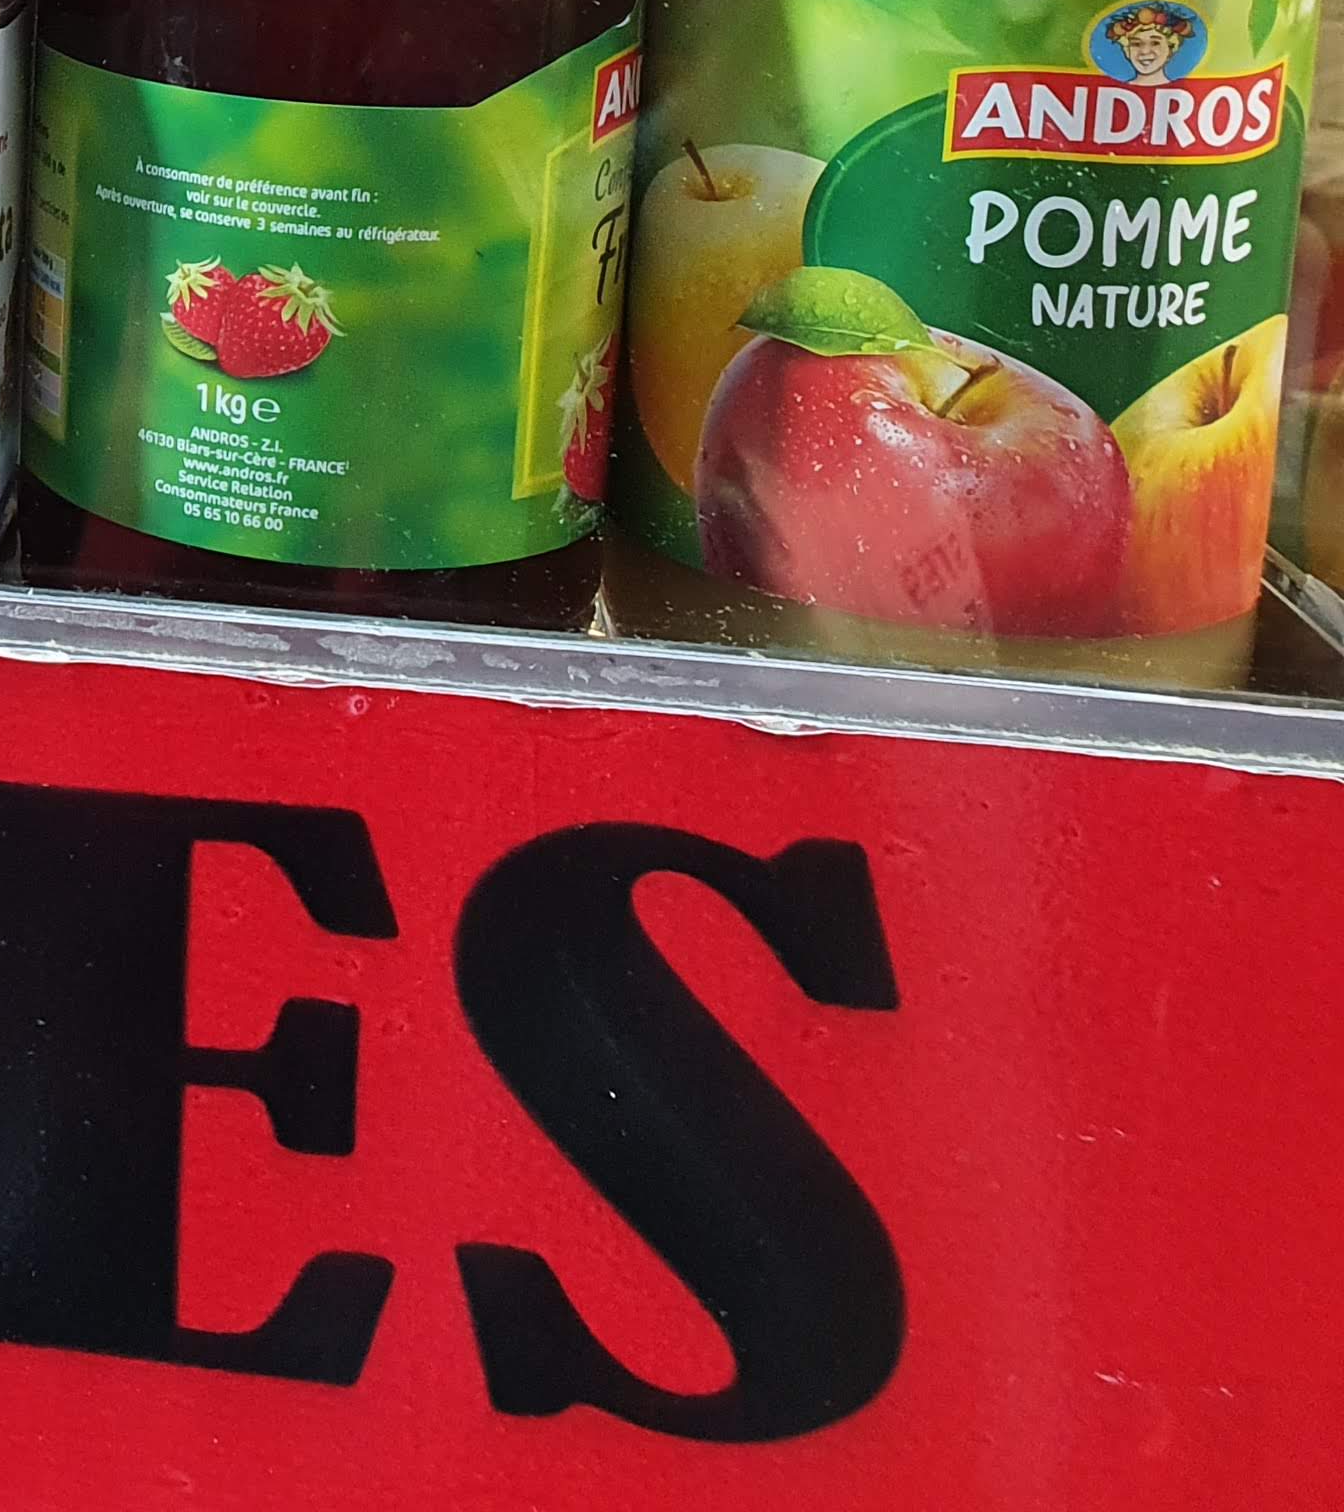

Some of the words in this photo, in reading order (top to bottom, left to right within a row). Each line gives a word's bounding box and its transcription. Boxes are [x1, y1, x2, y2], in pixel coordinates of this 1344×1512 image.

[962, 78, 1274, 148] ANDROS
[135, 156, 144, 175] À
[145, 163, 215, 187] consommer
[216, 173, 234, 191] de
[235, 177, 308, 200] préférence
[310, 188, 350, 204] avant
[350, 188, 372, 205] fin
[95, 183, 123, 205] Après
[123, 193, 178, 221] ouverture,
[179, 206, 194, 221] se
[195, 210, 252, 230] conserve
[256, 217, 266, 232] 3
[269, 219, 333, 239] semaines
[335, 225, 353, 240] au
[358, 227, 442, 246] réfrigérateur.
[185, 189, 211, 207] voir
[213, 194, 235, 210] sur
[236, 194, 249, 212] le
[251, 196, 322, 219] couvercle.
[965, 188, 1259, 270] POMME
[1031, 280, 1211, 330] NATURE
[137, 428, 175, 448] 46130
[288, 457, 348, 476] FRANCE
[190, 425, 249, 449] ANDROS
[260, 438, 285, 454] Z.I.
[178, 469, 229, 492] Service
[231, 479, 293, 502] Relation
[183, 456, 290, 486] www.andros.fr
[154, 478, 267, 515] Consommateurs
[269, 502, 320, 521] France
[183, 501, 201, 518] 05
[203, 506, 221, 522] 65
[223, 510, 241, 526] 10
[242, 514, 261, 529] 66
[263, 517, 285, 532] 00
